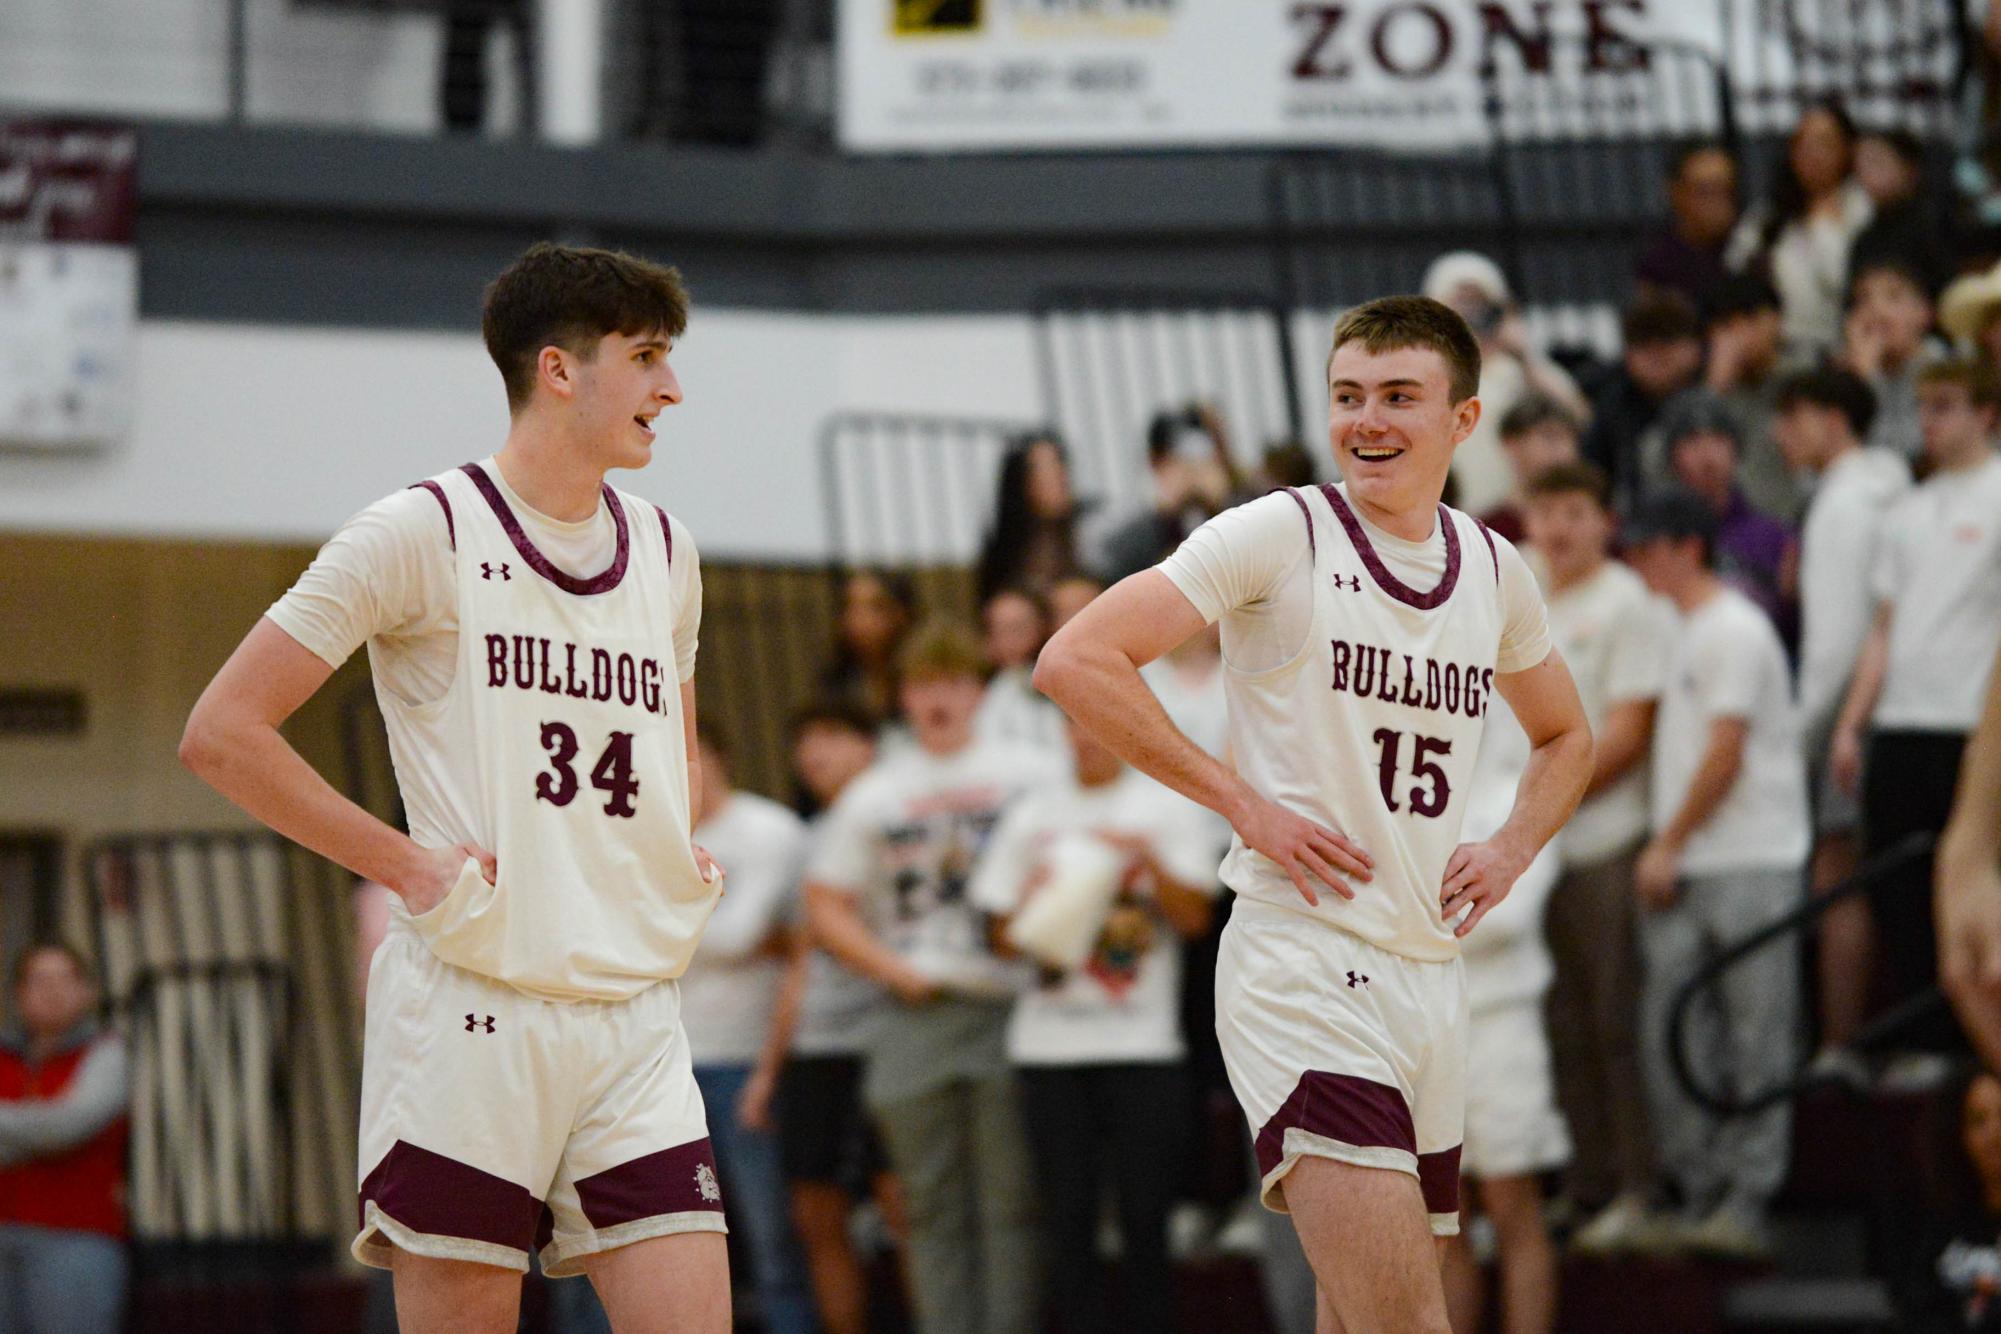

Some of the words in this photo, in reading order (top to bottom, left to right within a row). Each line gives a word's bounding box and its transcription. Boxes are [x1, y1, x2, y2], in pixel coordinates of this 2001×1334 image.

[1287, 0, 1653, 79] ZONE
[485, 634, 667, 716] BULLDOG
[536, 719, 640, 818] 34
[1373, 728, 1452, 818] 15
